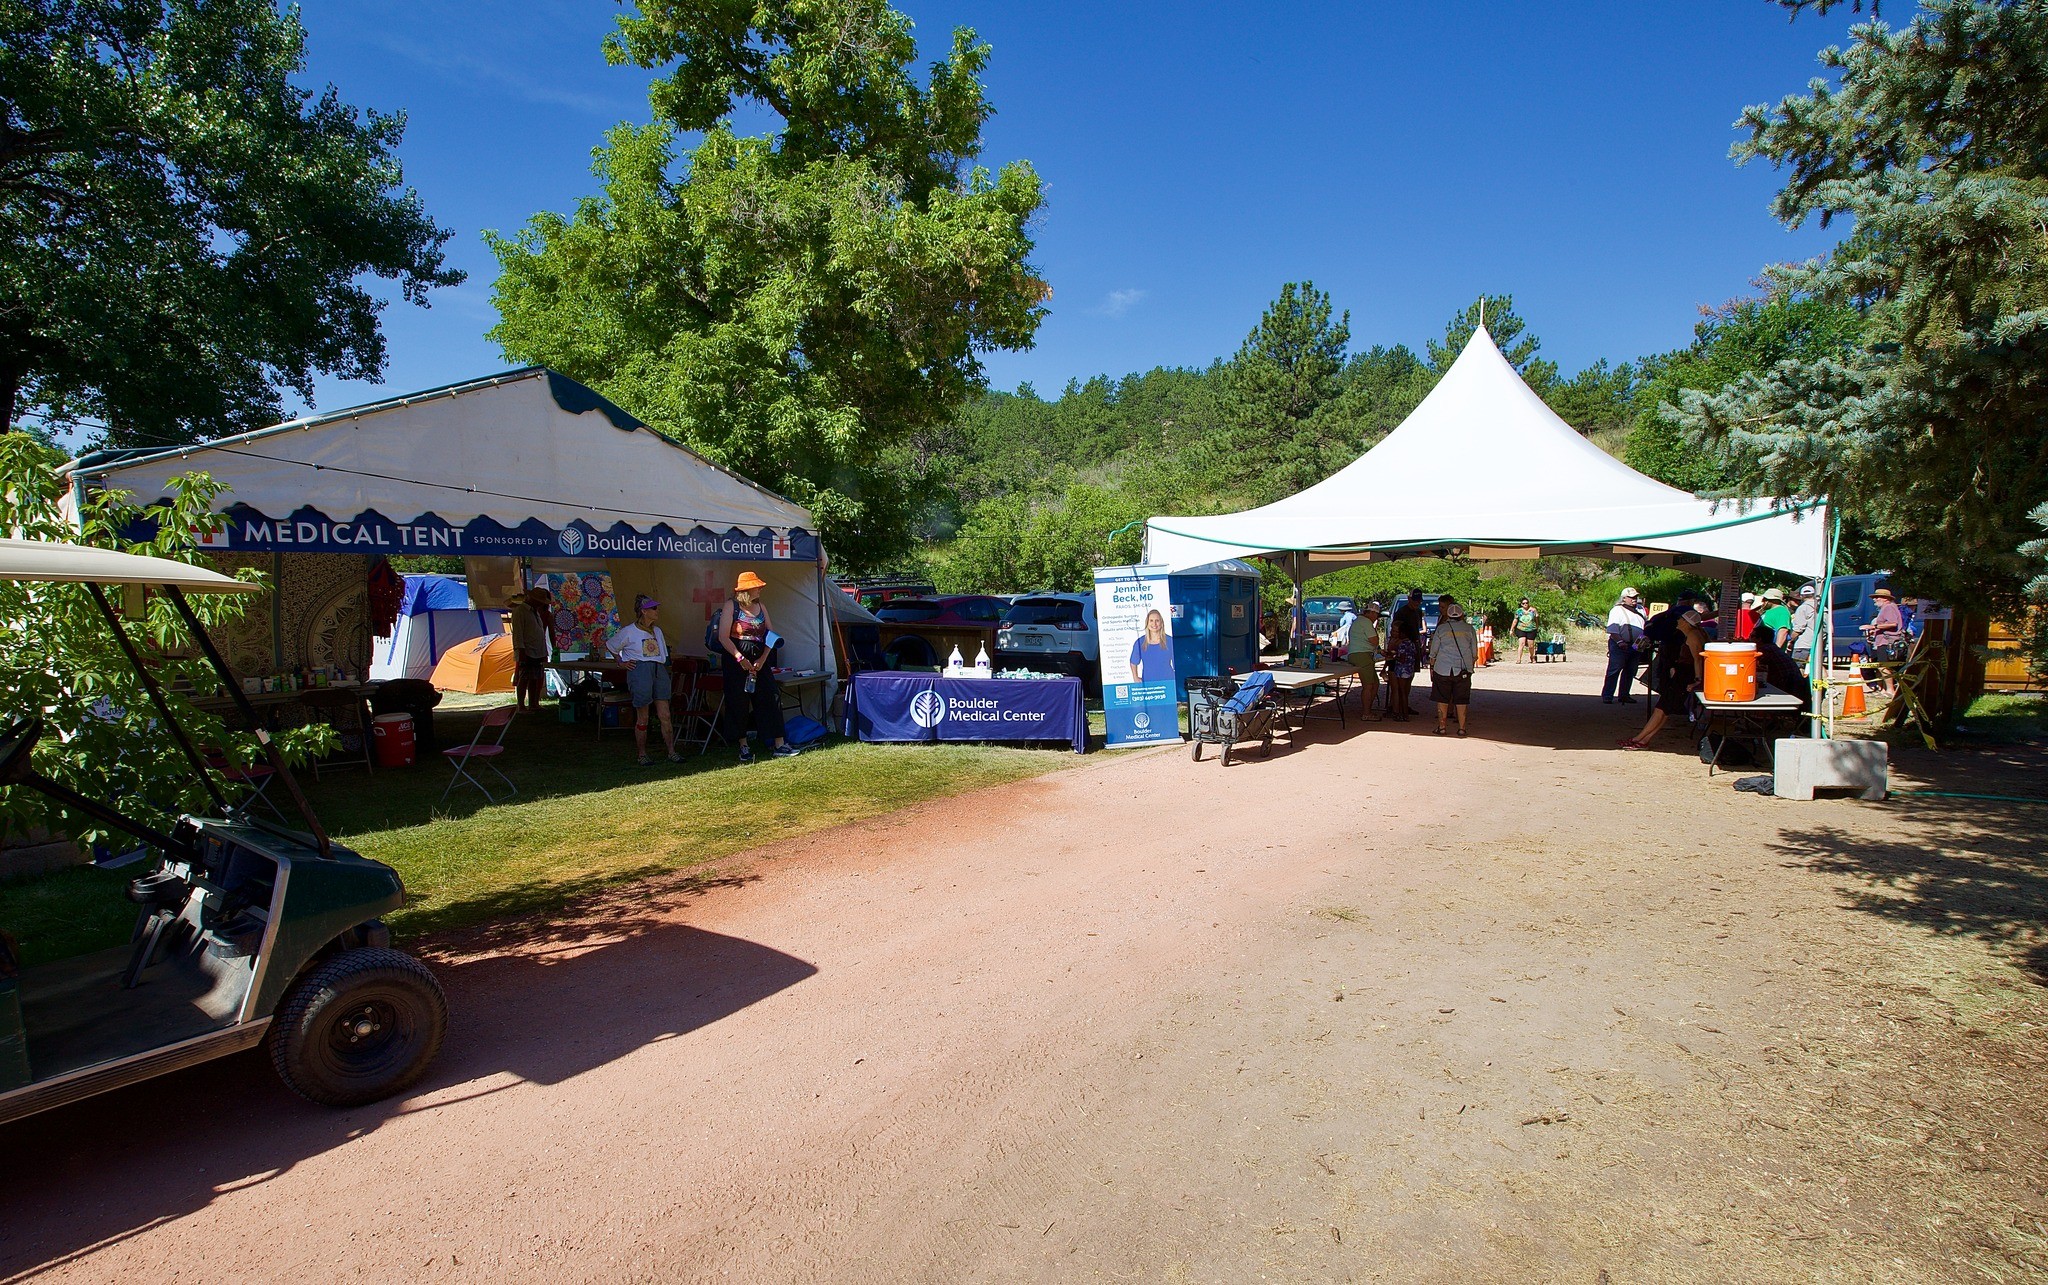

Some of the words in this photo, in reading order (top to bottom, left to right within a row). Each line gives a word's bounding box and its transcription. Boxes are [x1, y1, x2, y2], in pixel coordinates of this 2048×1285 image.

[244, 520, 390, 546] MEDICAL
[396, 525, 465, 547] TENT
[473, 536, 534, 545] SPONSORED
[537, 538, 549, 546] BY
[587, 532, 653, 552] Boulder
[657, 536, 718, 553] Medical
[721, 538, 767, 554] Center
[1114, 583, 1152, 594] Jennifer
[1112, 594, 1138, 603] Beck,
[1140, 593, 1154, 601] MD
[948, 697, 999, 709] Boulder
[948, 710, 1000, 722] Medical
[1002, 710, 1046, 722] Center
